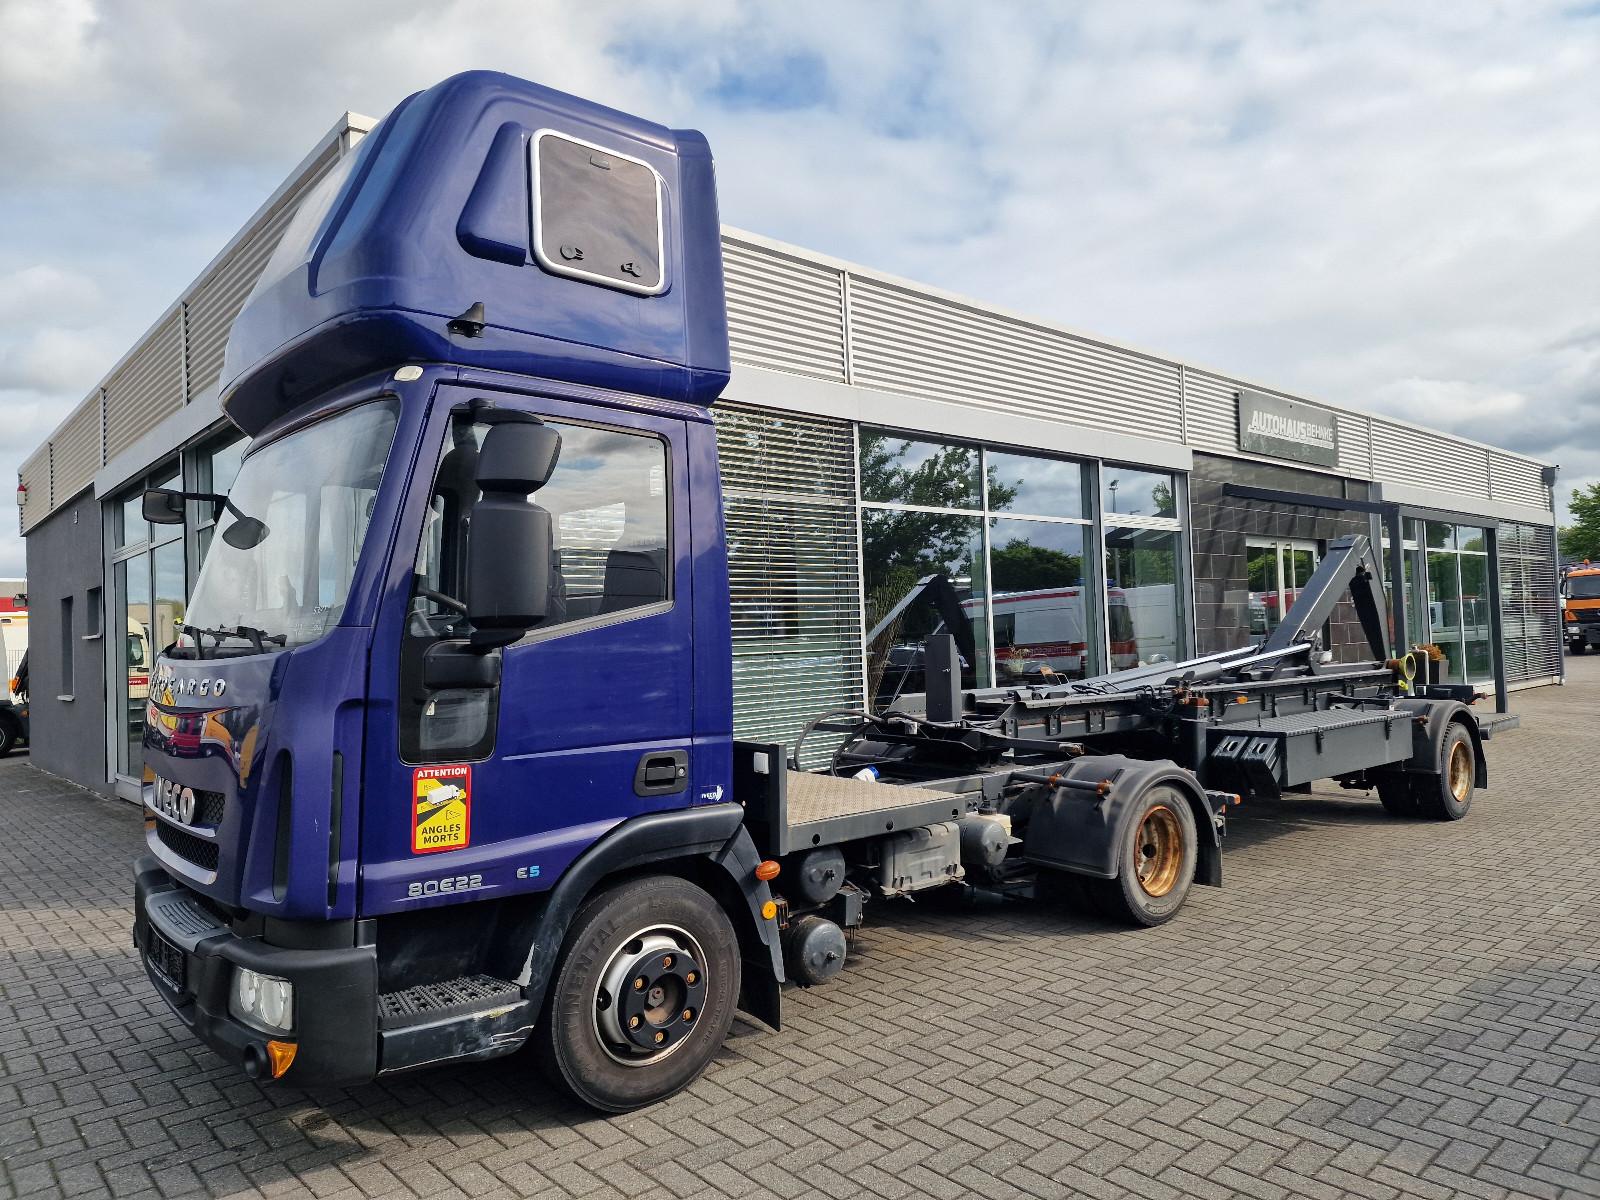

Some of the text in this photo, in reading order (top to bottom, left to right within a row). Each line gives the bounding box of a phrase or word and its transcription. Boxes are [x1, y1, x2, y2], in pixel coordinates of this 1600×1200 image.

[417, 767, 467, 778] ATTENTION
[154, 773, 195, 825] IVECO
[421, 824, 461, 835] ANGLES
[423, 833, 459, 844] MORTS
[408, 874, 483, 897] 80E22
